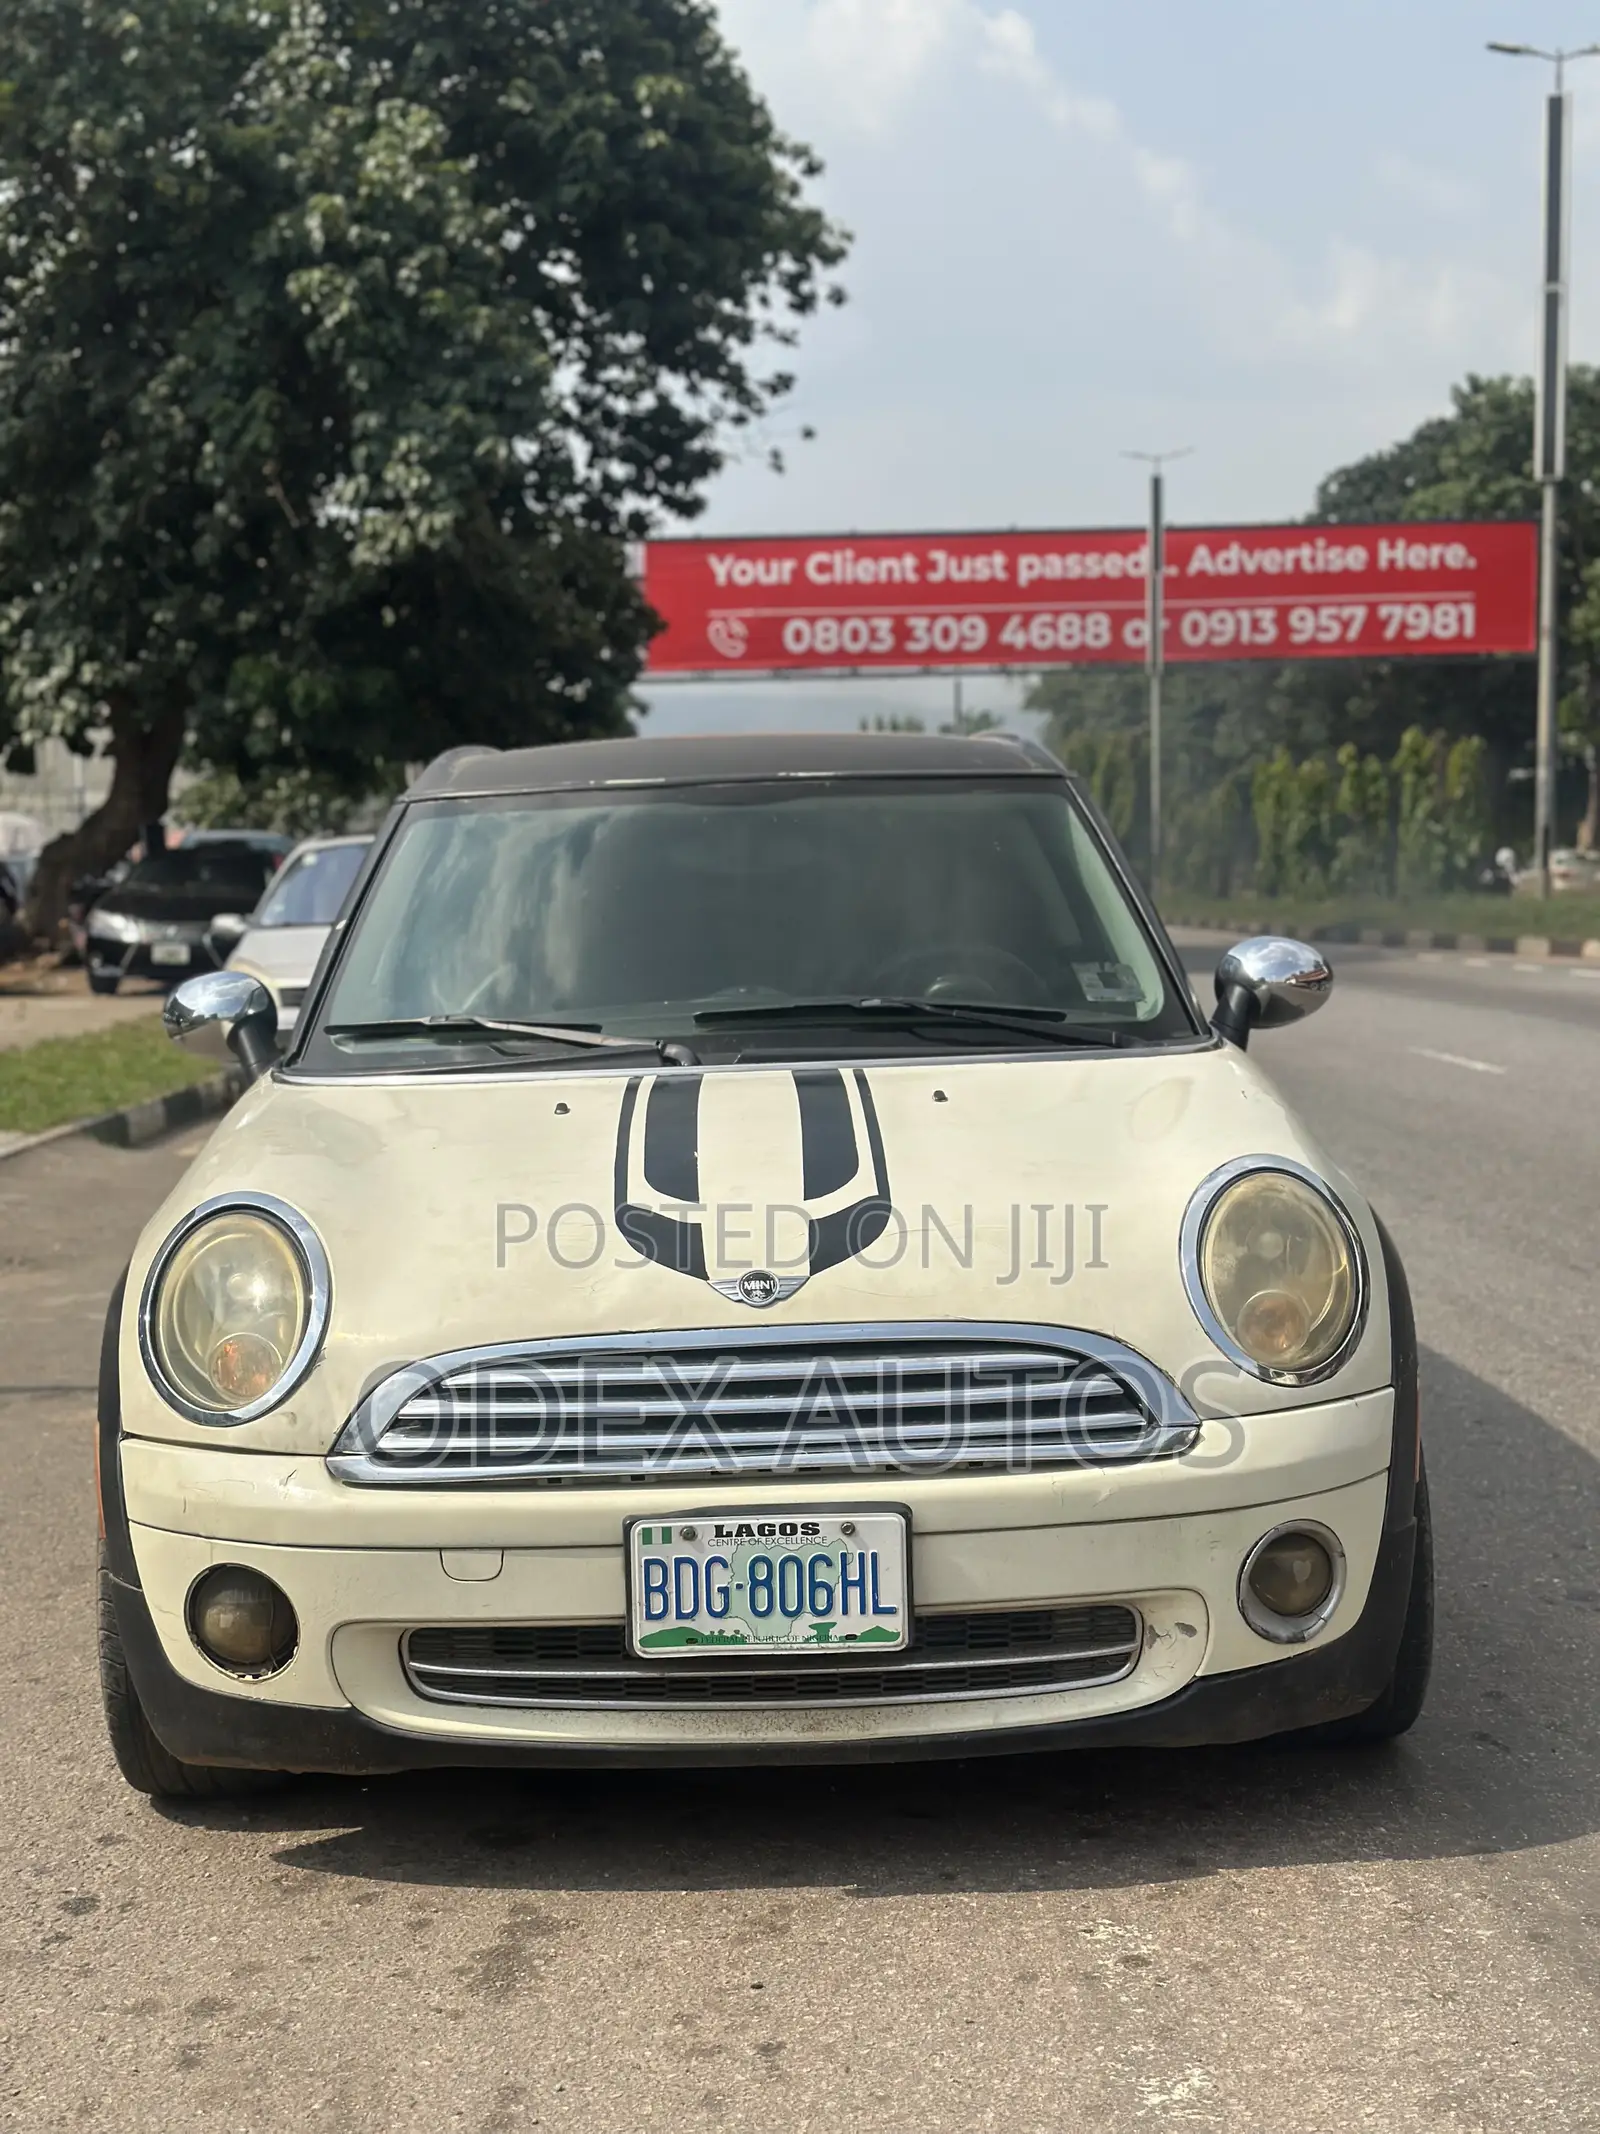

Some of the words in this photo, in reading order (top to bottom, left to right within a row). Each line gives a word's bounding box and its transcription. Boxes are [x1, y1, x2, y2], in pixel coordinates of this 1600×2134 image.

[706, 553, 798, 587] Your
[805, 549, 919, 584] Client
[926, 547, 1007, 583] Just
[1187, 537, 1369, 577] Advertise
[1377, 537, 1477, 572] Here.
[782, 615, 895, 655] 0803
[904, 614, 988, 653] 309
[998, 611, 1112, 651] 4688
[1181, 606, 1277, 648] 0913
[1288, 604, 1367, 644] 957
[1378, 601, 1476, 641] 7981
[744, 1280, 775, 1292] MINI
[714, 1522, 820, 1538] LAGOS
[707, 1537, 746, 1548] CENTRE
[748, 1536, 762, 1546] OF
[766, 1535, 828, 1546] EXCELLENCE
